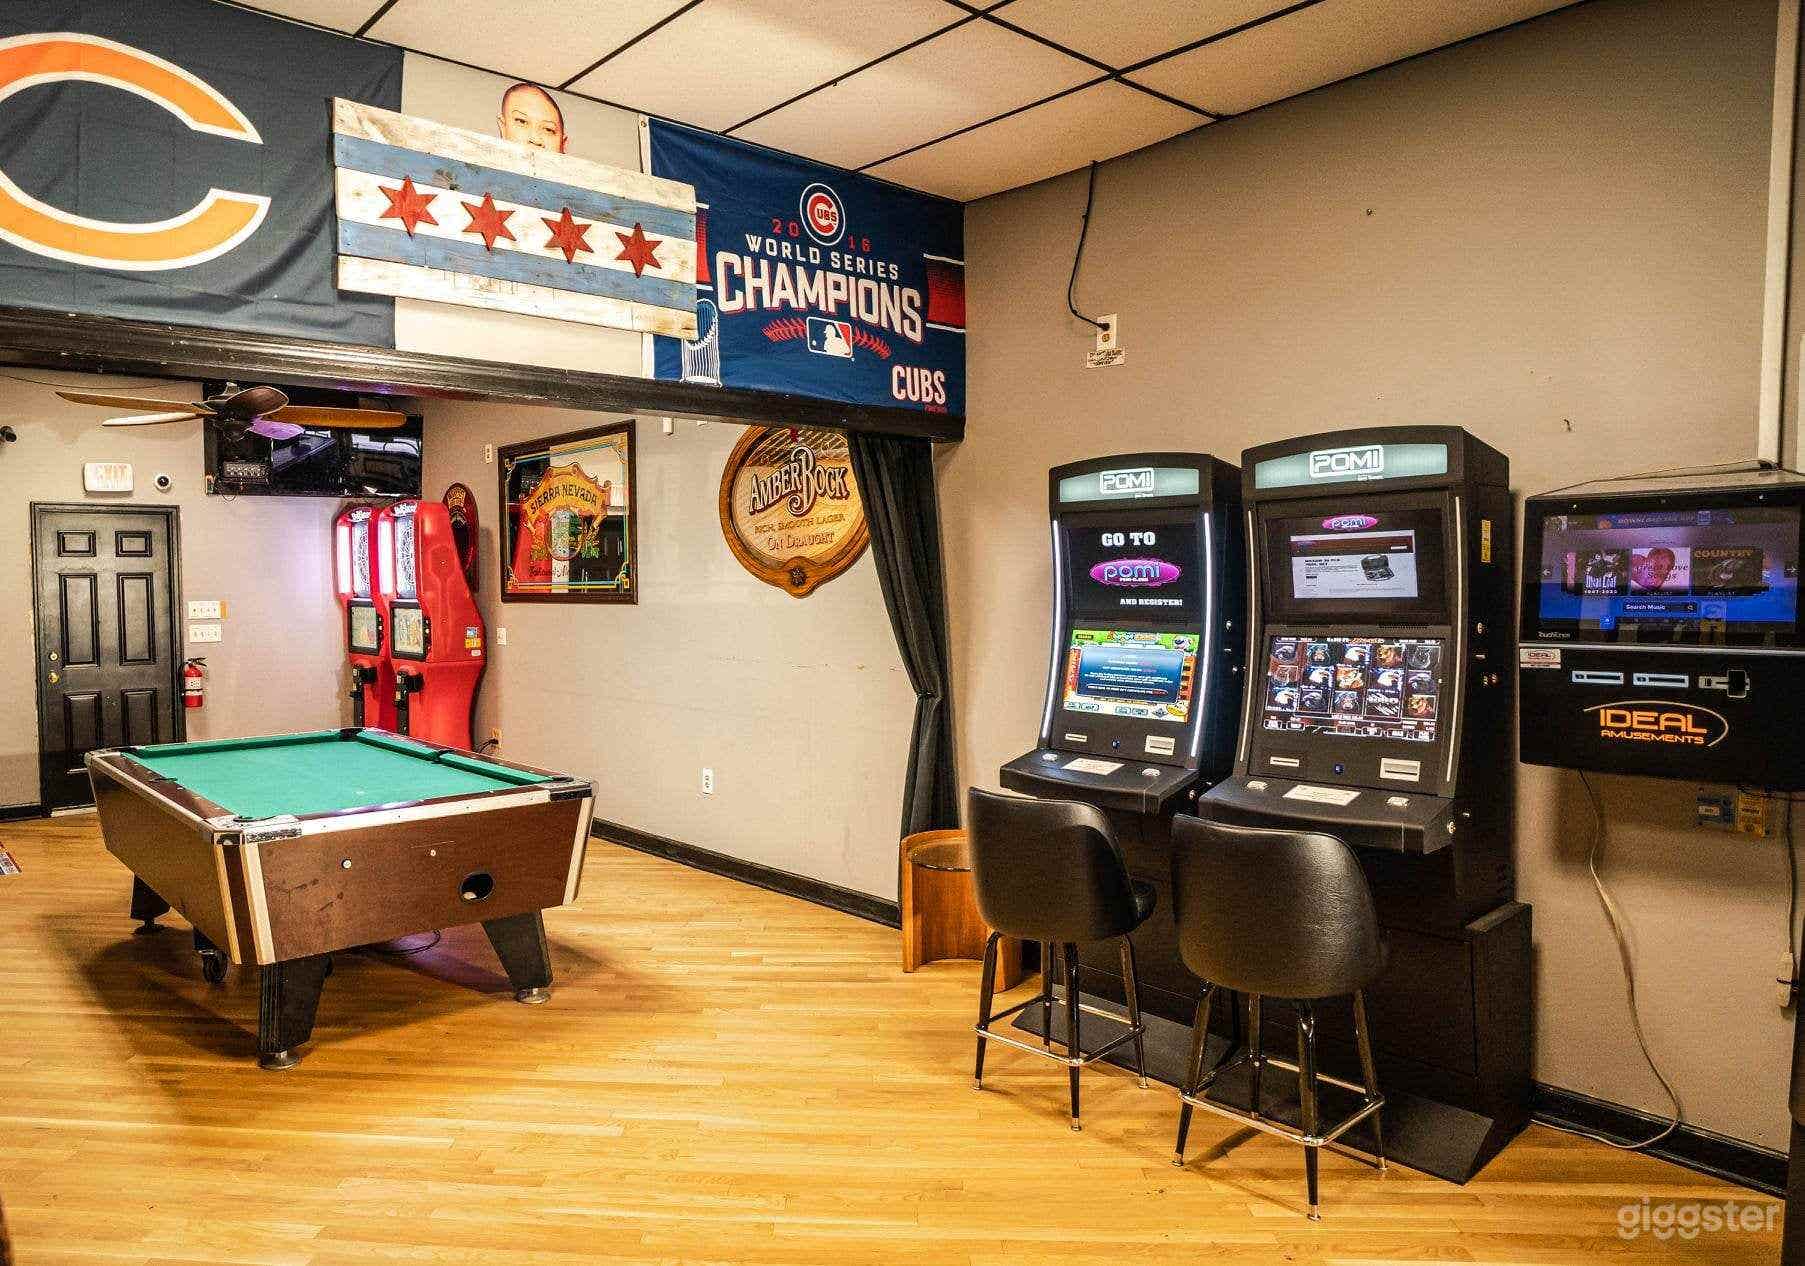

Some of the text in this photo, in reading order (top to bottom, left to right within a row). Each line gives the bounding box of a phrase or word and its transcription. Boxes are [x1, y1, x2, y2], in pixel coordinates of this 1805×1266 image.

[745, 233, 898, 280] WORLD SERIES
[716, 250, 923, 344] CHAMPIONS
[892, 365, 946, 405] CUBS
[530, 484, 599, 515] SIERRA NEVADA
[816, 512, 846, 525] LAGER
[786, 531, 835, 549] DRAUGHT
[1101, 531, 1156, 547] GO TO
[1104, 561, 1160, 581] pomi
[1600, 708, 1707, 734] IDEAL
[1601, 729, 1705, 745] AMUSEMENTS
